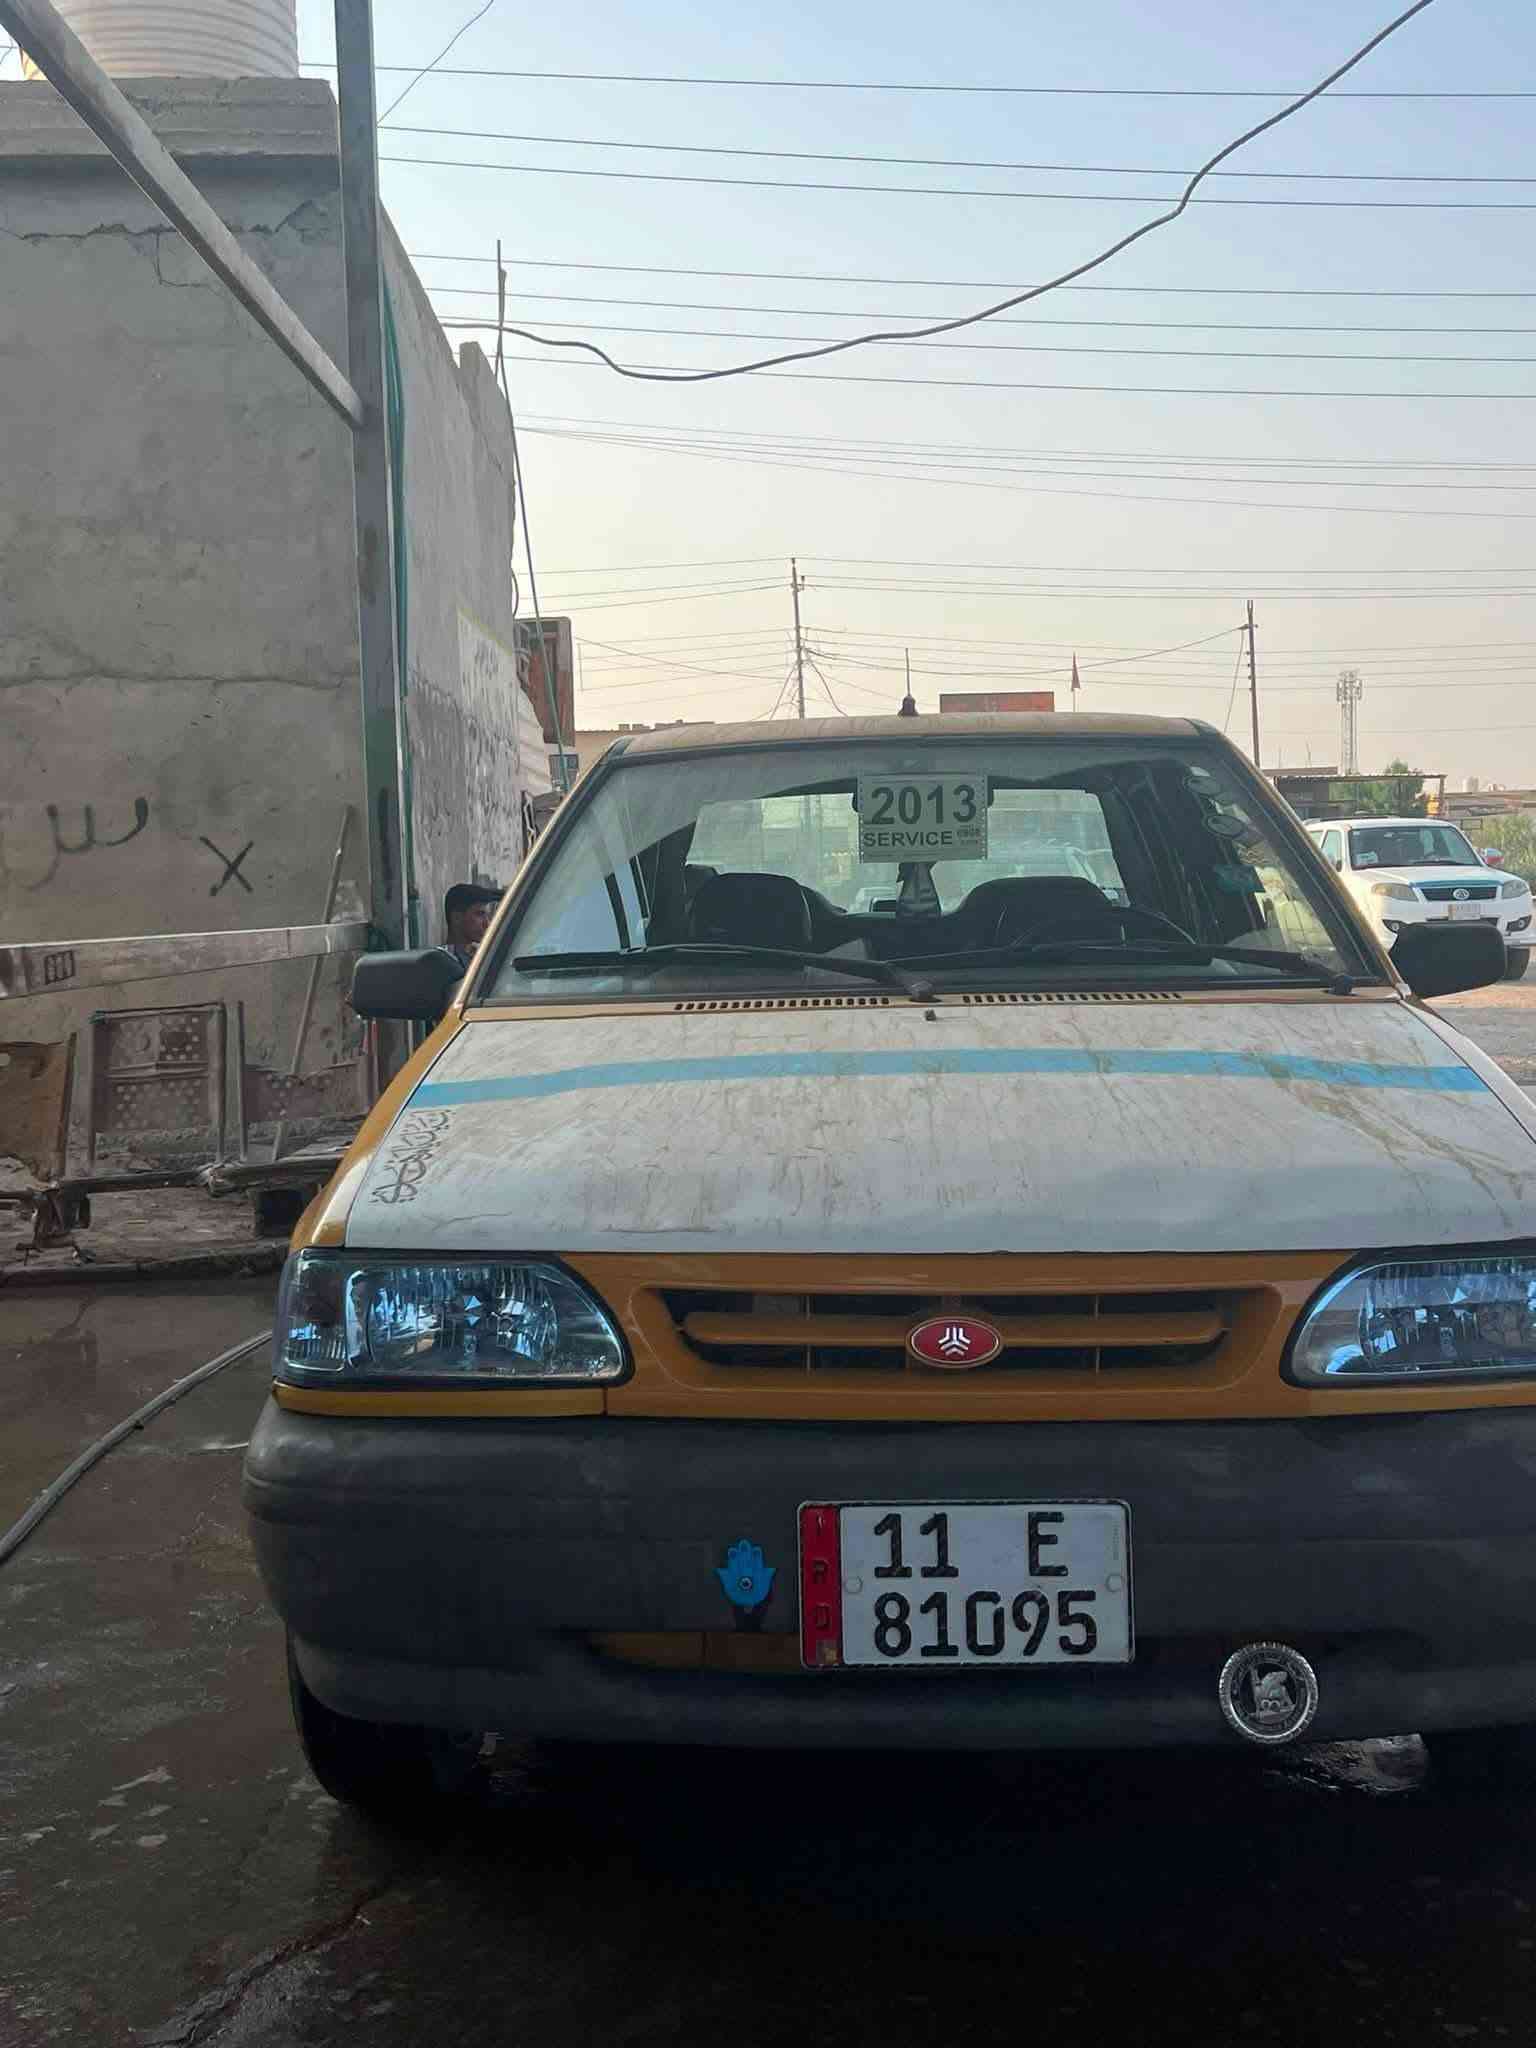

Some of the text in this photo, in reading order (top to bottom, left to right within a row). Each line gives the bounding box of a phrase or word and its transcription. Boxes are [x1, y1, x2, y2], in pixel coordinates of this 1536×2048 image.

[871, 784, 977, 825] 2013
[864, 830, 953, 848] SERVICE
[874, 1512, 960, 1578] 11
[1027, 1511, 1069, 1577] E
[874, 1589, 1098, 1657] 81095
